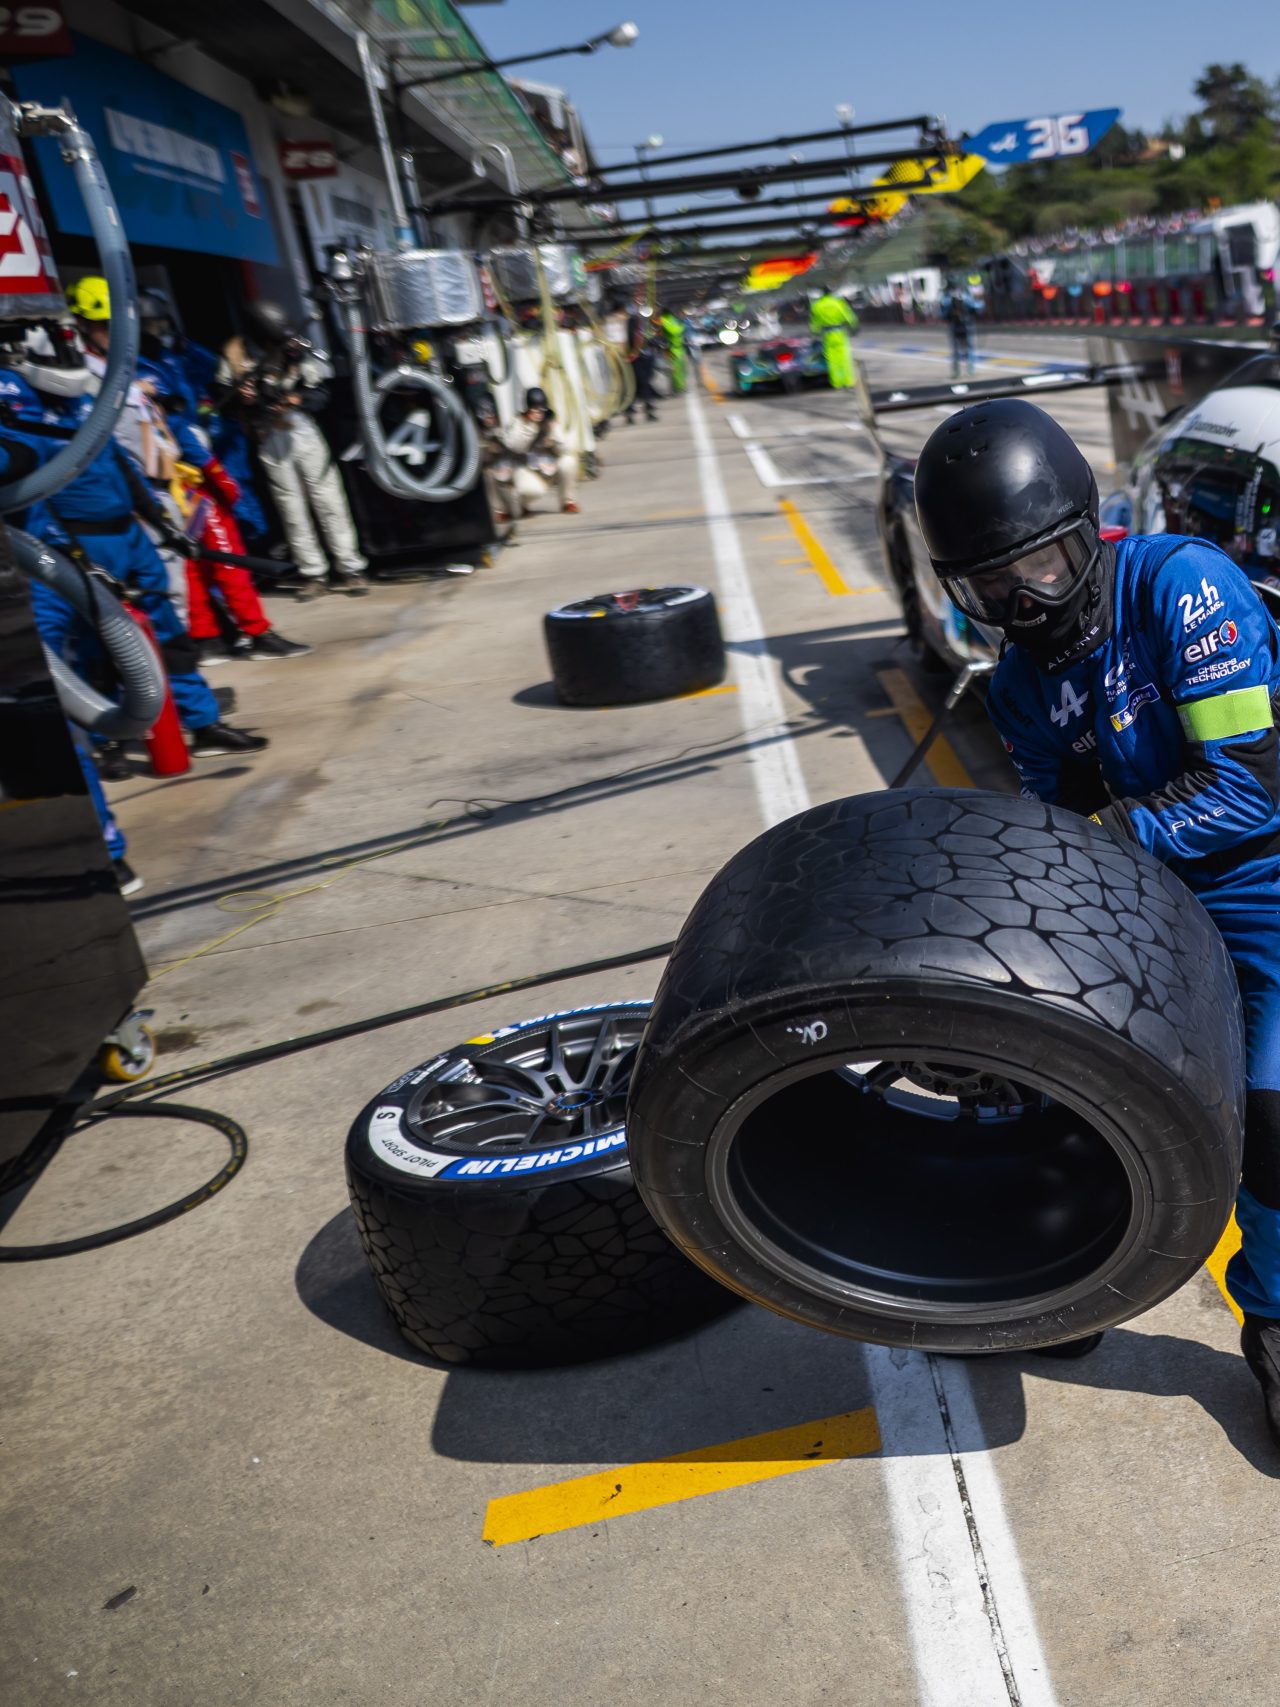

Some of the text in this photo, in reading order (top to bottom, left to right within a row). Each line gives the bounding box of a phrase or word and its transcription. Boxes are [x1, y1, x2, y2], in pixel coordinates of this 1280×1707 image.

[1024, 114, 1090, 160] 36
[1184, 602, 1222, 634] LE MANS
[1183, 629, 1220, 664] elf
[1186, 658, 1252, 686] TECHNOLOGY
[1197, 657, 1237, 675] CHEOPS
[381, 1139, 408, 1157] SPORT
[403, 1154, 439, 1168] PILOT
[457, 1131, 627, 1175] MICHELIN
